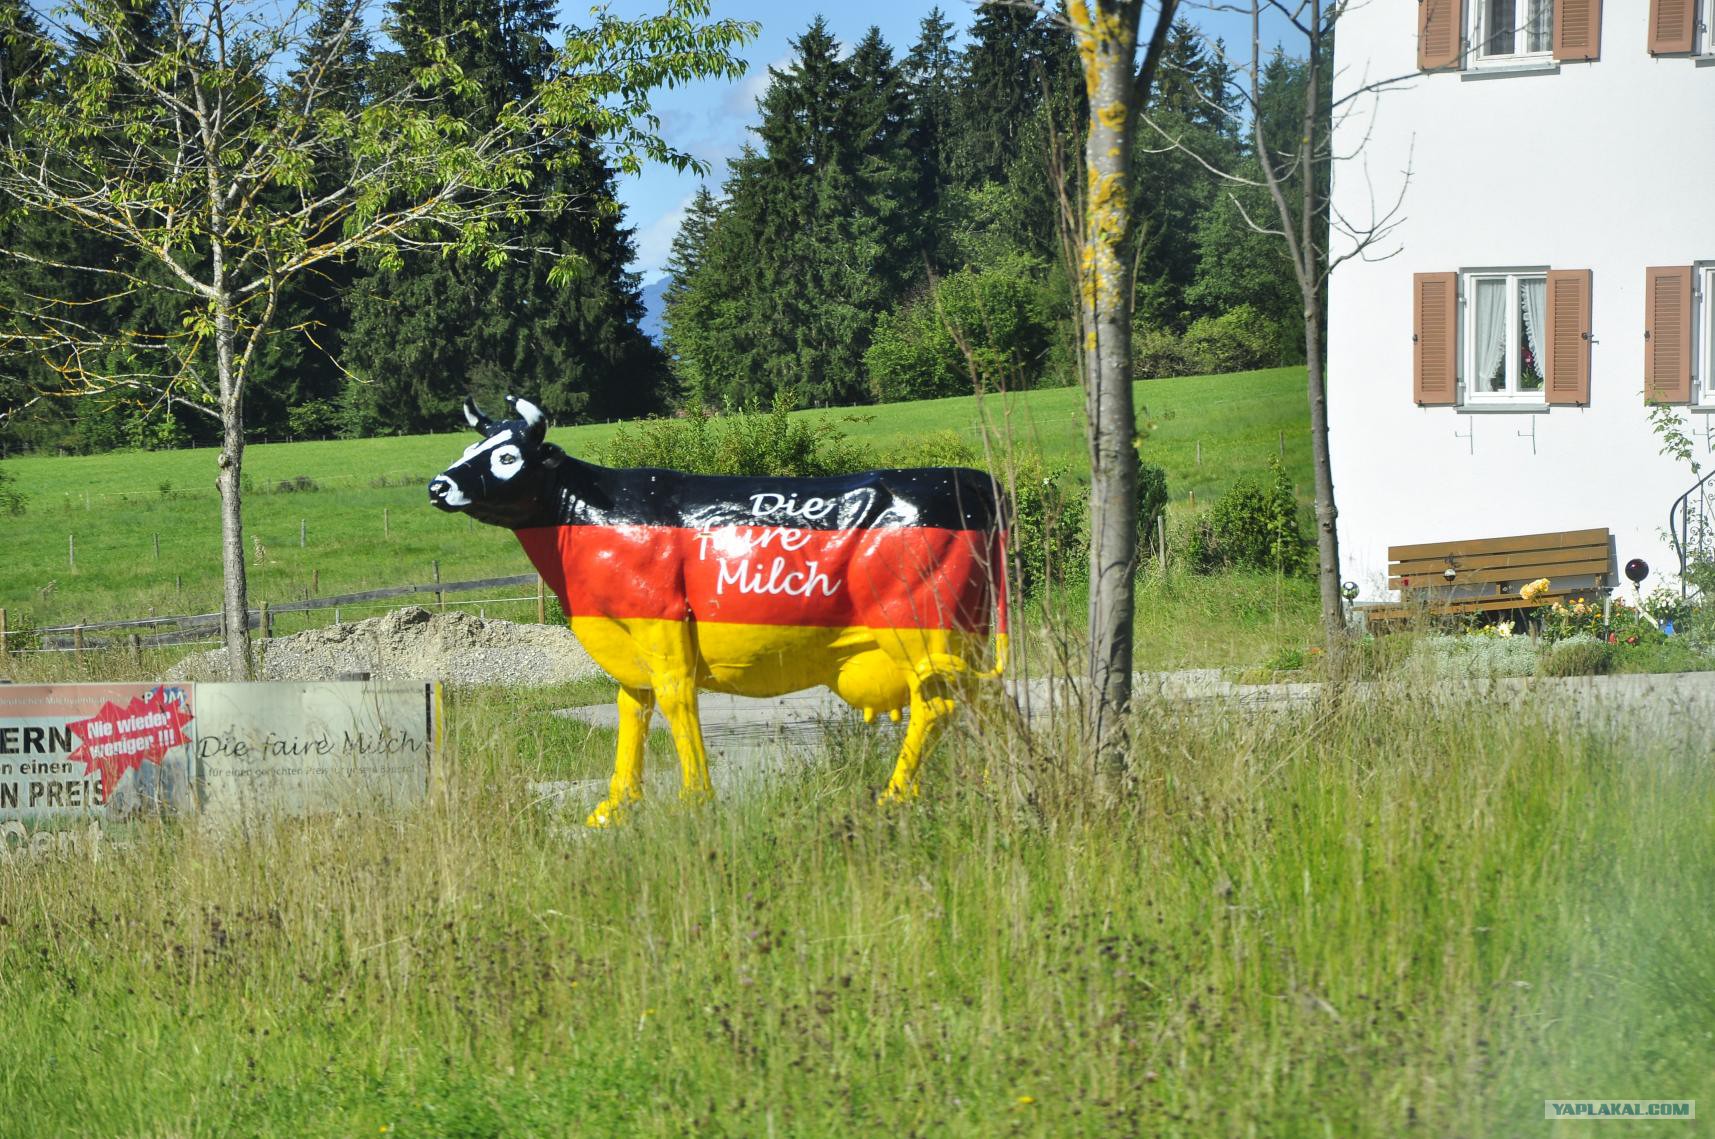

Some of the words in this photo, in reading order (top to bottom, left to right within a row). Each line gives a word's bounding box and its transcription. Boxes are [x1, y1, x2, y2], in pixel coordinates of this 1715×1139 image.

[750, 493, 835, 519] Die
[716, 556, 841, 597] Milch
[87, 720, 113, 739] Nie
[116, 711, 171, 734] wieder
[0, 726, 72, 754] ERN
[89, 735, 154, 759] weniger
[199, 735, 249, 758] Die
[20, 759, 72, 774] einen
[29, 780, 104, 807] PREIS
